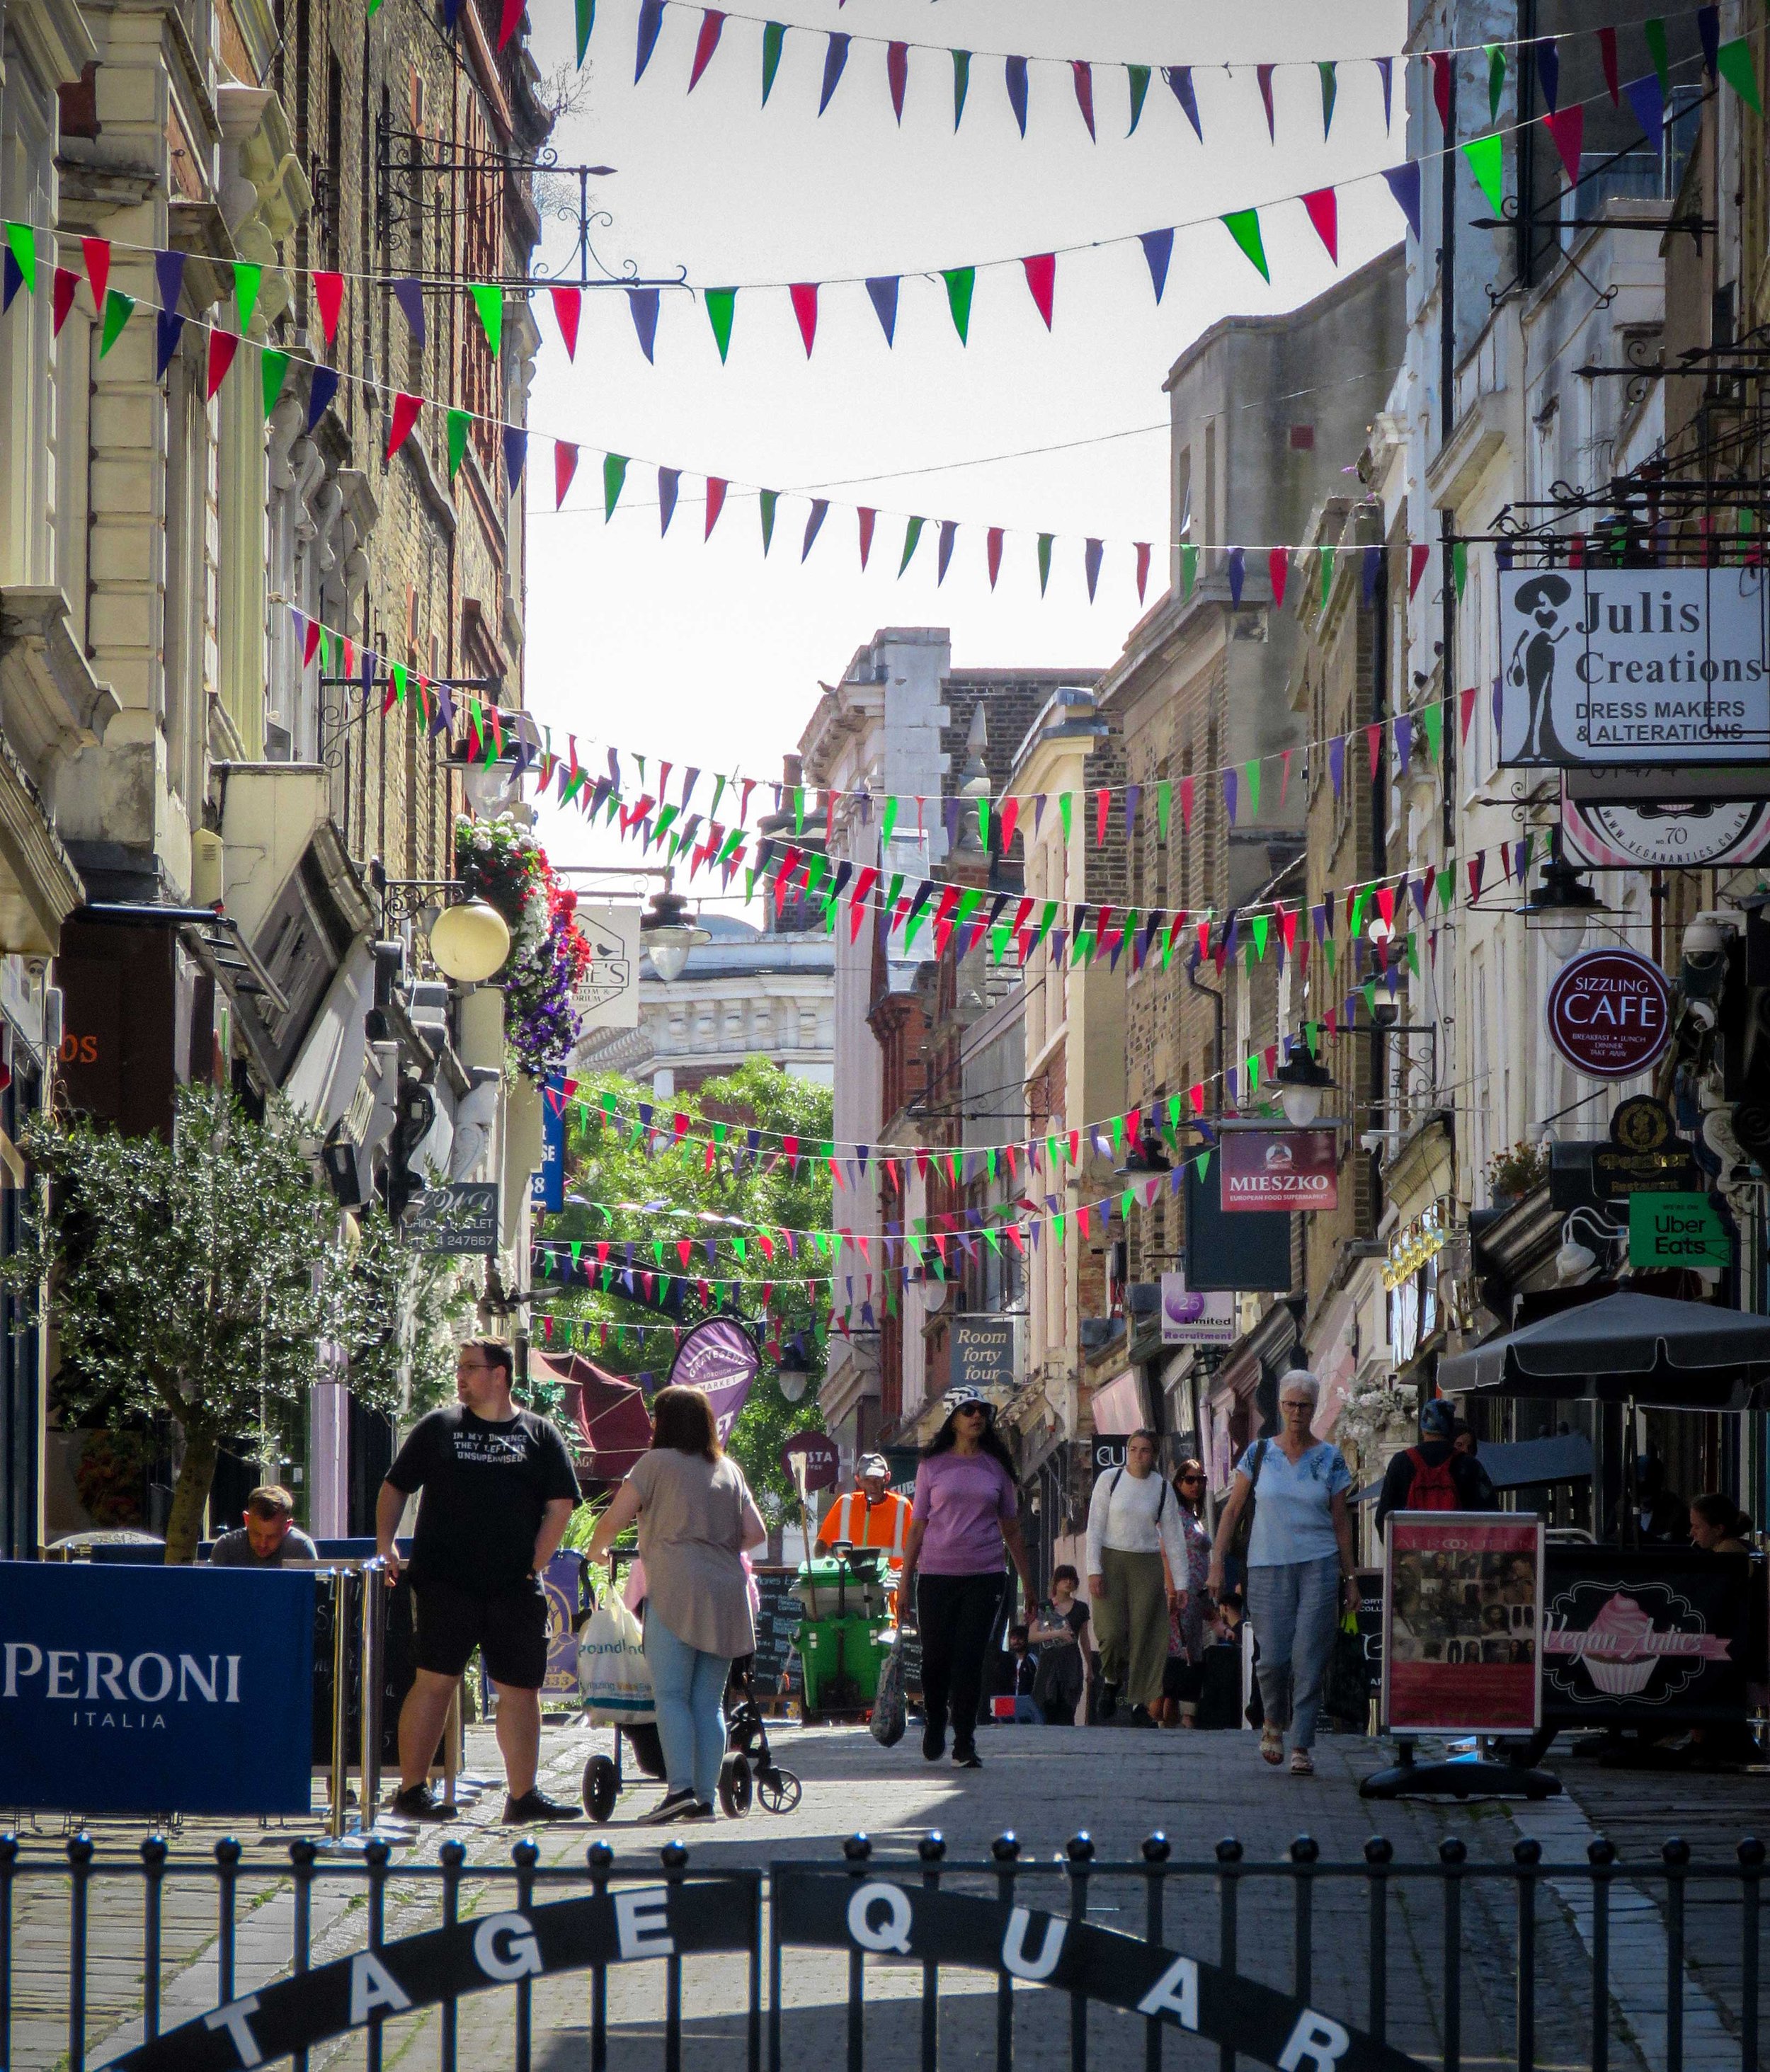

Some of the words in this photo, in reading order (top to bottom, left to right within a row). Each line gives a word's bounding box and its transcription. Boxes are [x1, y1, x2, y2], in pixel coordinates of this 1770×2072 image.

[1575, 591, 1700, 634] Julis
[1575, 650, 1762, 684] Creations
[1575, 702, 1648, 719] DRESS
[1654, 701, 1745, 718] MAKERS
[1576, 725, 1588, 741] &
[1597, 723, 1743, 741] ALTERATIONS
[1665, 826, 1688, 845] 70
[1575, 977, 1648, 993] SIZZLING
[1564, 993, 1657, 1026] CAFE
[1572, 1033, 1610, 1041] BREAKFAST
[1230, 1175, 1329, 1191] MIESZKO
[1655, 1215, 1706, 1234] Uber
[447, 1236, 493, 1246] 247667
[1655, 1237, 1706, 1254] Eats
[957, 1329, 1007, 1344] Room
[1164, 1332, 1232, 1340] Recruitment
[690, 1351, 746, 1378] GRAVESEND
[962, 1347, 1002, 1366] forty
[703, 1368, 731, 1378] BOROUGH
[965, 1365, 1000, 1380] four
[700, 1376, 737, 1391] MARKET
[468, 1433, 484, 1441] MY
[454, 1441, 479, 1450] THEY
[457, 1451, 523, 1463] UNSUPERVISED
[2, 1643, 241, 1702] PERONI
[73, 1712, 166, 1729] ITALIA
